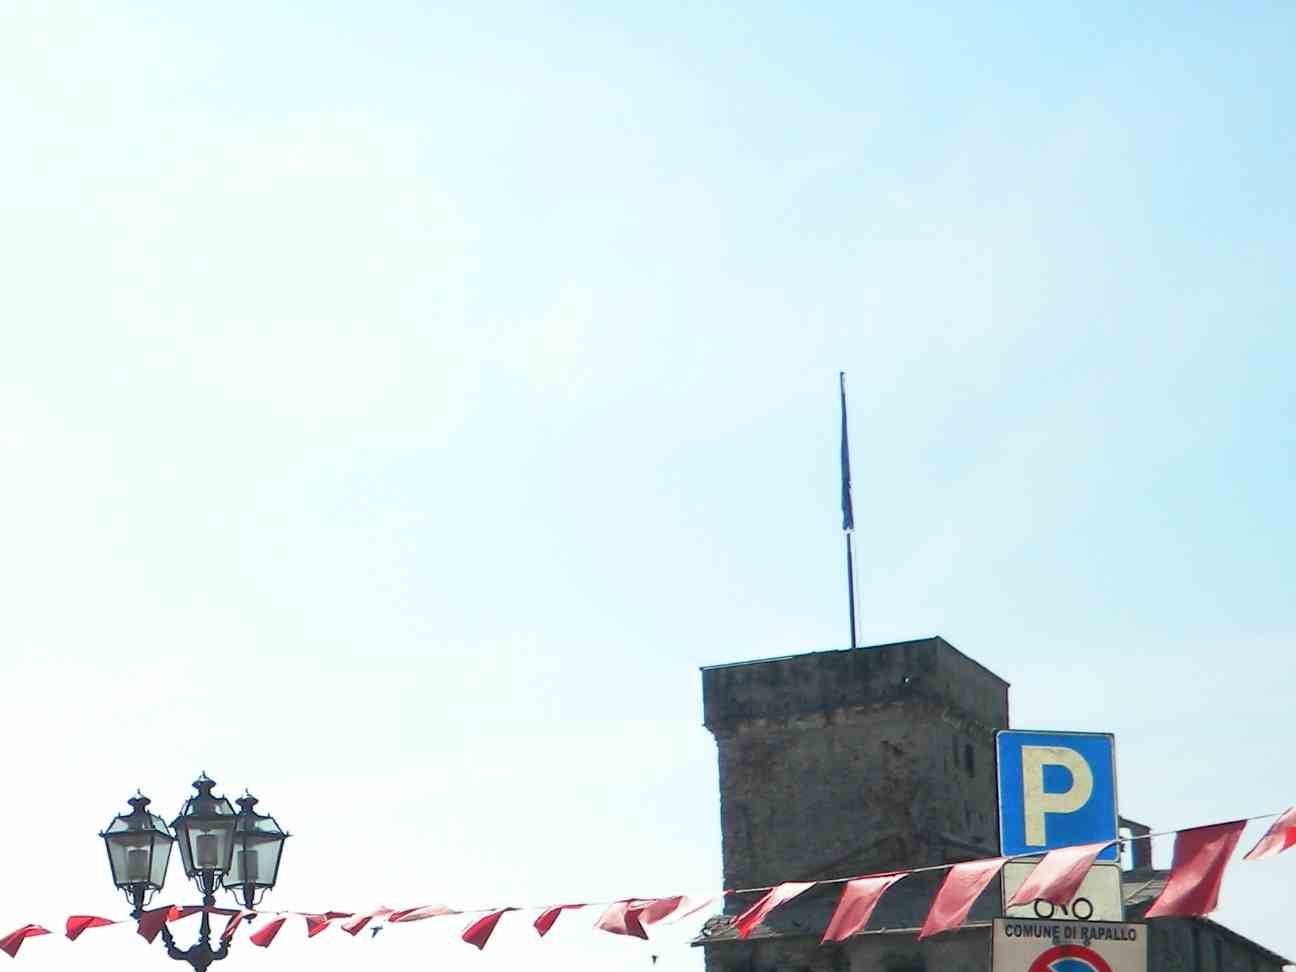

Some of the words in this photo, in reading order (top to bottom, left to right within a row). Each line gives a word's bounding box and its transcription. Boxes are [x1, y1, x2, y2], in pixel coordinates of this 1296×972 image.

[1021, 745, 1094, 847] P
[1005, 924, 1060, 939] COMUNE
[1064, 926, 1077, 940] DI
[1081, 927, 1137, 941] RAPALLO
